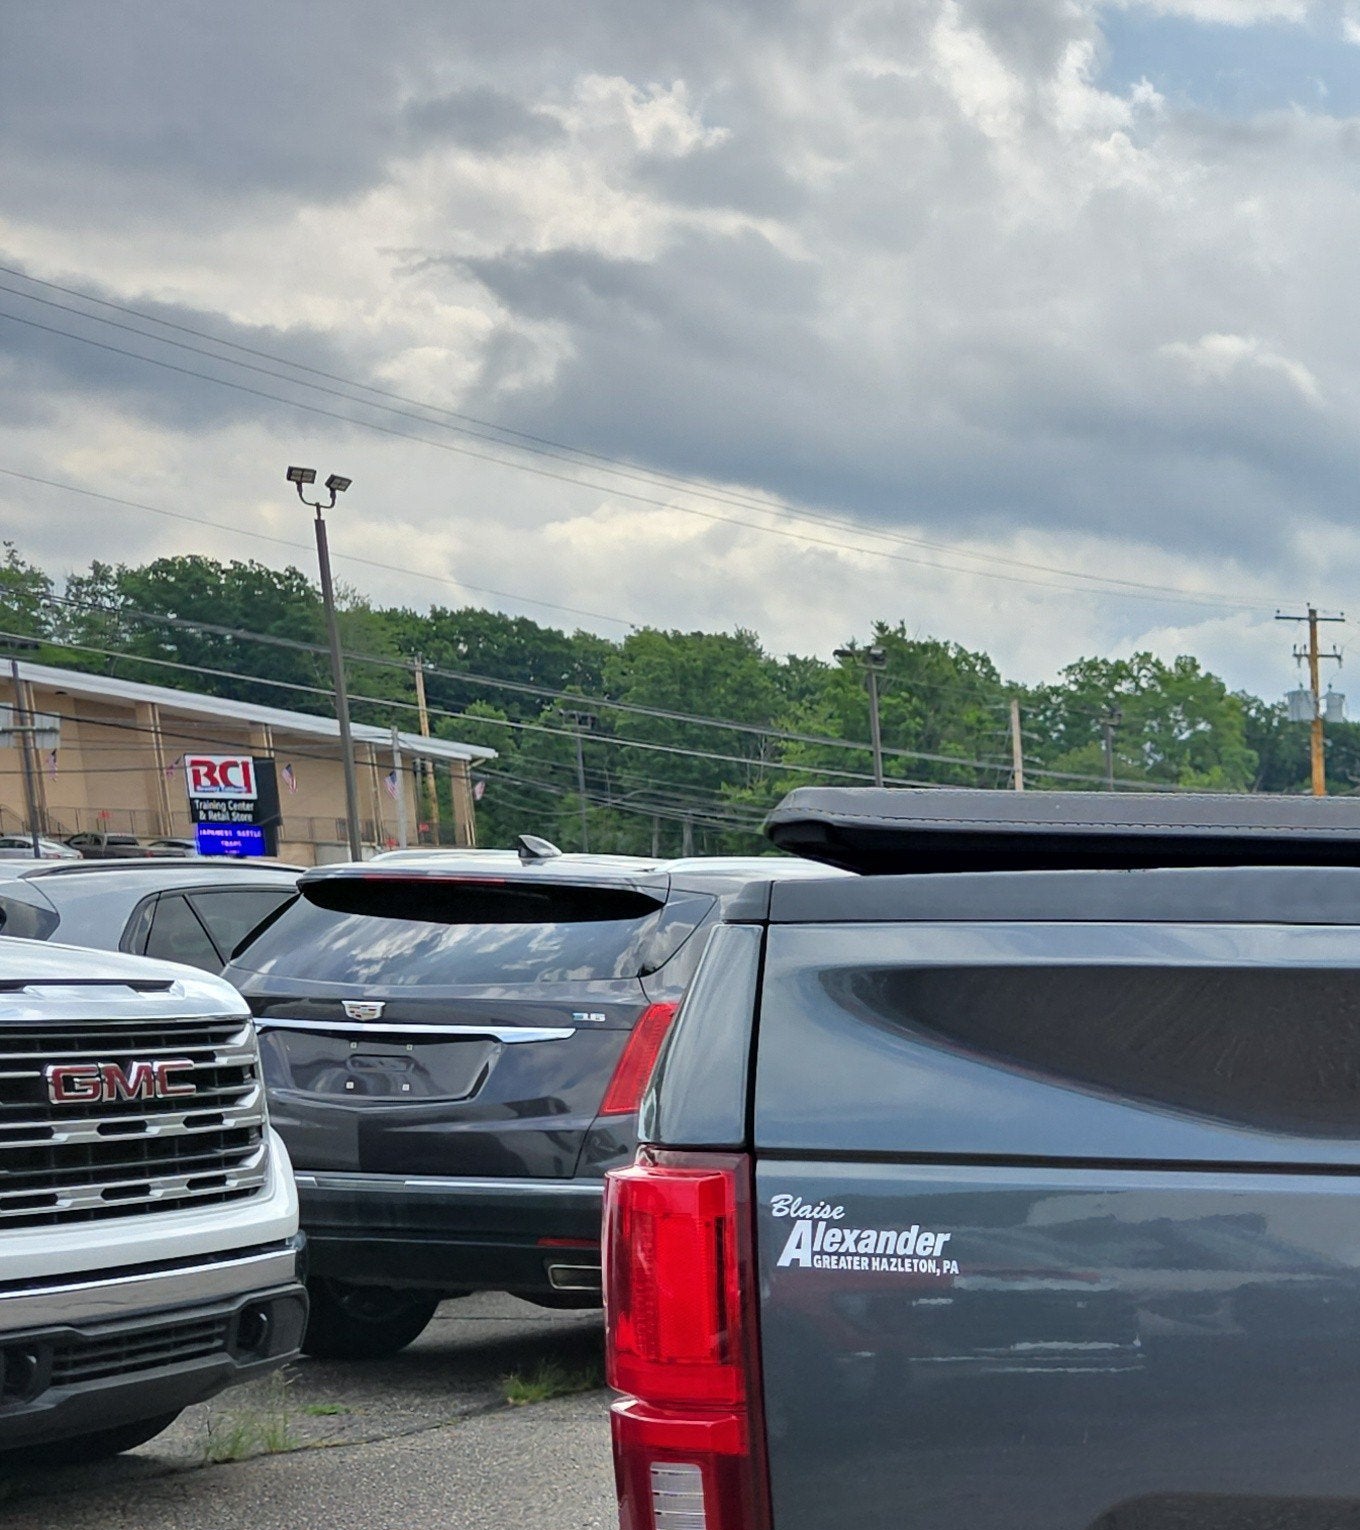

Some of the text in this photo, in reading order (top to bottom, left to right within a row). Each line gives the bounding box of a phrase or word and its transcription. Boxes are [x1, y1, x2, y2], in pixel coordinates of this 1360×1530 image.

[191, 760, 253, 794] RCI
[194, 799, 254, 812] Training Center
[208, 811, 230, 821] Retail
[231, 812, 253, 822] Store
[46, 1058, 197, 1105] GMC
[770, 1194, 846, 1220] Blaise
[776, 1219, 952, 1268] Alexander
[813, 1254, 960, 1277] GREATER HAZLETON, PA
